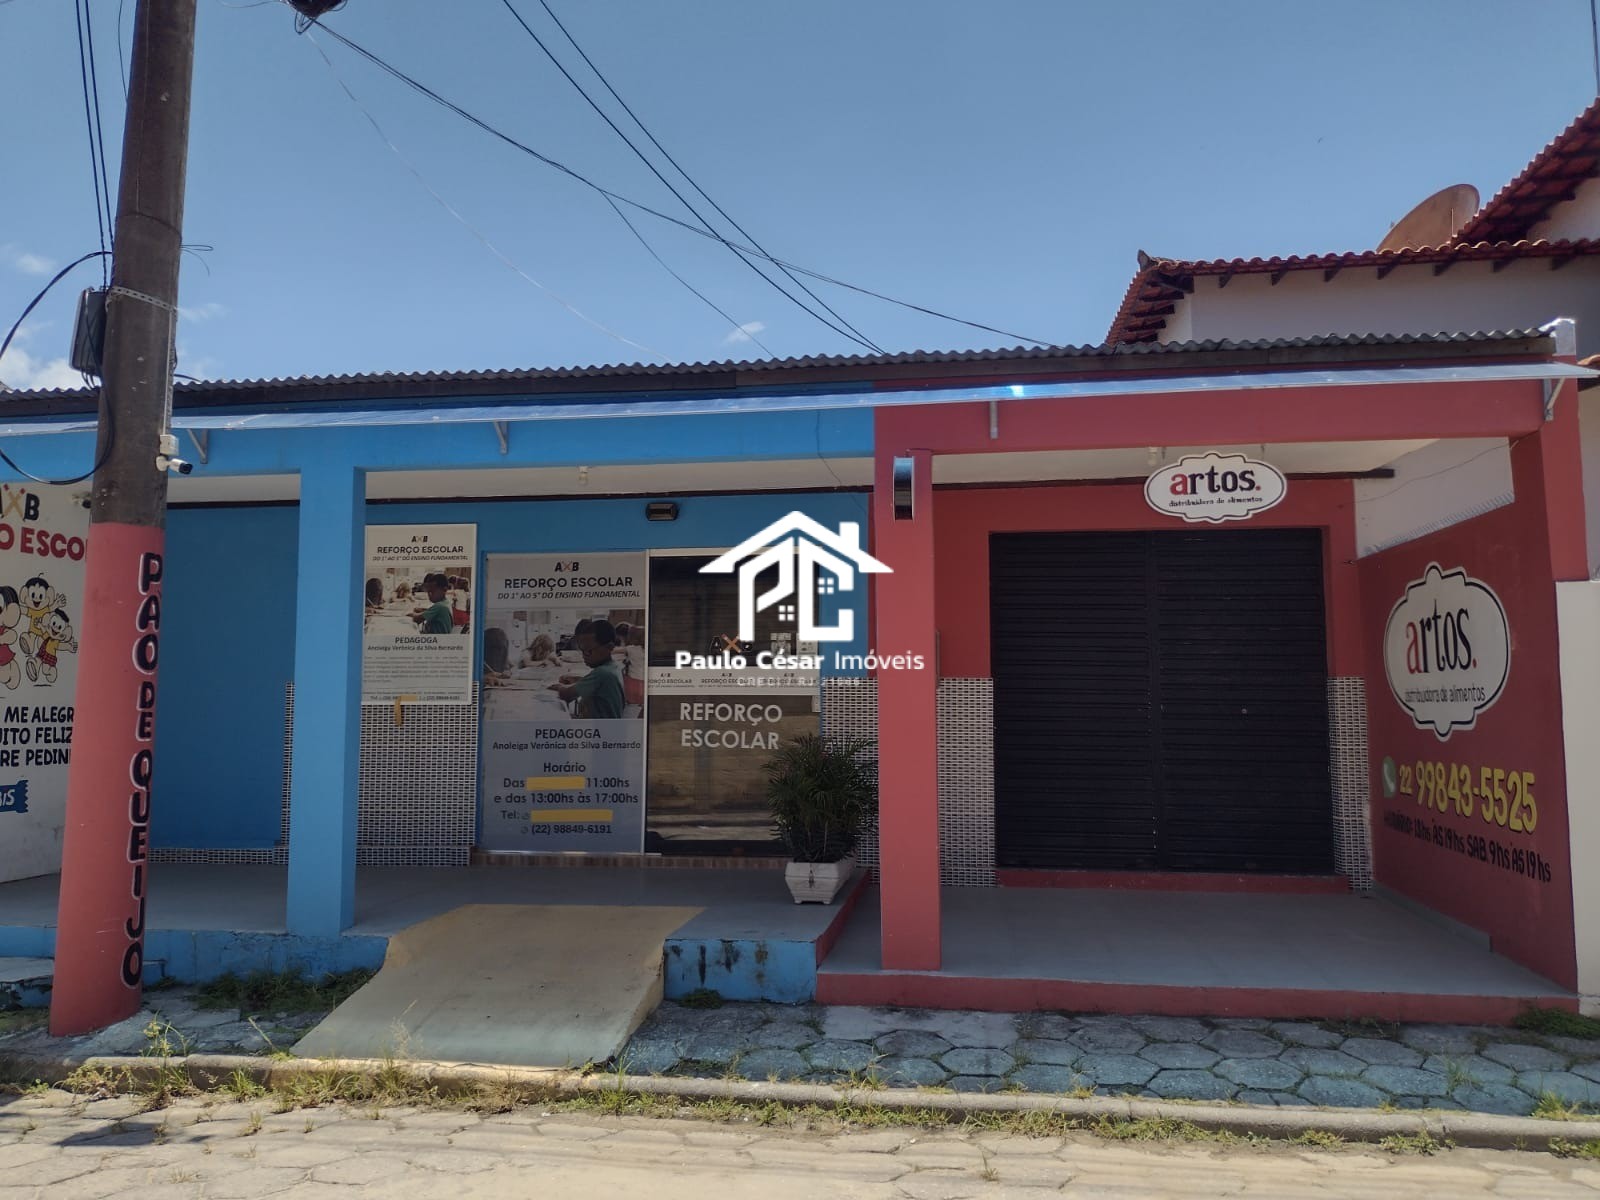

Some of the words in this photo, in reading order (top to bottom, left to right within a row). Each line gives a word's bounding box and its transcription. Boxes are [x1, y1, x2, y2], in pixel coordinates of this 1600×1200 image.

[1169, 464, 1262, 495] artos.
[1227, 496, 1263, 504] alimentos
[20, 527, 88, 561] ESCO
[377, 546, 420, 556] REFORÇO
[421, 545, 464, 554] ESCOLAR
[504, 578, 567, 591] REFORÇO
[571, 577, 633, 588] ESCOLAR
[584, 590, 640, 599] FUNDAMENTAL
[1405, 599, 1478, 675] artos.
[4, 706, 29, 723] ME
[136, 681, 155, 742] DE
[680, 702, 782, 726] REFORÇO
[535, 728, 601, 739] PEDAGOGA
[681, 729, 780, 750] ESCOLAR
[581, 741, 601, 749] Silva
[602, 741, 641, 749] Bernardo
[25, 749, 71, 766] PEDIN
[543, 761, 586, 773] Horário
[503, 778, 526, 788] Das
[587, 777, 630, 788] 11:00hs
[494, 795, 502, 803] e
[505, 793, 527, 804] das
[531, 793, 574, 804] 13:00hs
[578, 792, 591, 803] às
[595, 792, 639, 804] 17:00hs
[1399, 764, 1413, 796] 22
[1415, 760, 1538, 836] 99843-5525
[501, 810, 520, 820] Tel:
[531, 824, 551, 836] (22)
[553, 824, 612, 834] 98849-6191
[120, 749, 153, 990] QUEIJO
